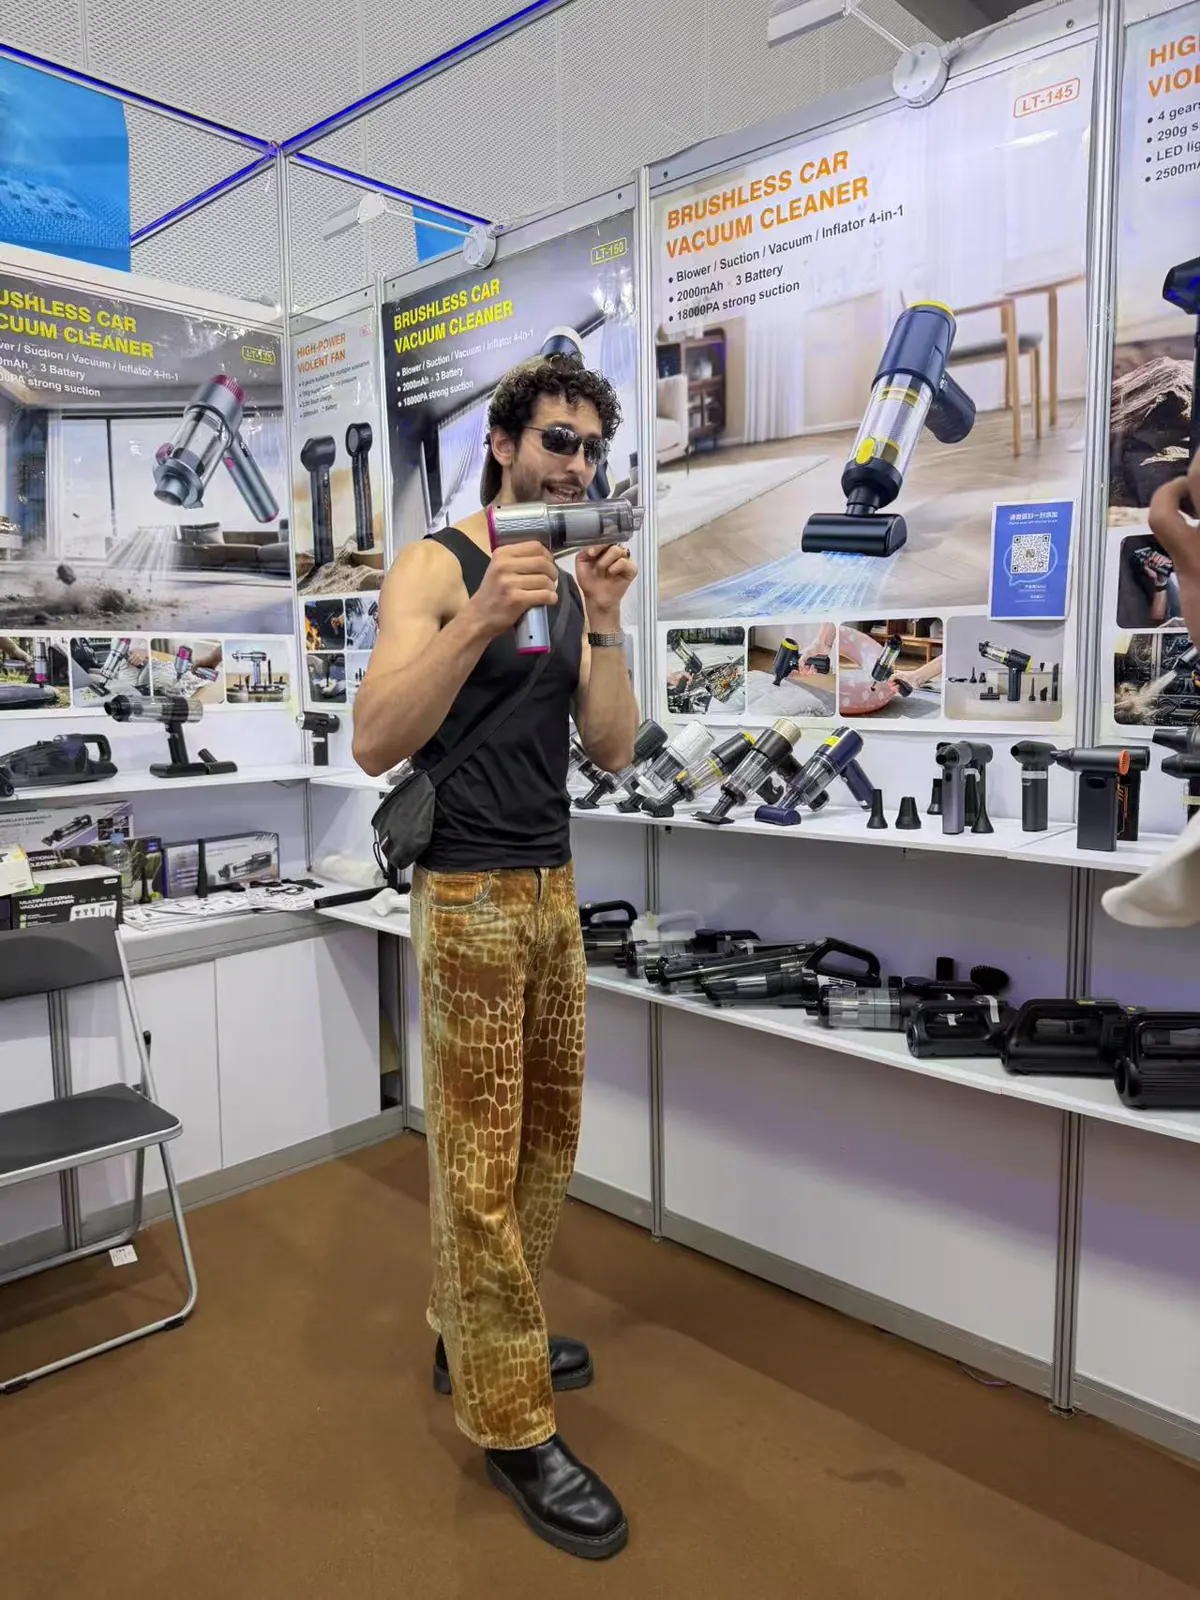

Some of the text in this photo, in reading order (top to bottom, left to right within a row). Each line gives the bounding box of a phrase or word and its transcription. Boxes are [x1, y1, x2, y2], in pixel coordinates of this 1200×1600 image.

[1023, 84, 1073, 112] LT-145
[1158, 111, 1165, 121] 4
[1157, 126, 1188, 142] 290g
[1157, 145, 1183, 161] LED
[667, 150, 849, 230] BRUSHLESS CAR
[666, 176, 869, 259] VACUUM CLEANER
[676, 264, 712, 282] Blower
[720, 251, 760, 270] Suction
[768, 234, 813, 255] Vacuum
[822, 217, 866, 239] Inflator
[869, 204, 904, 224] 4-in-1
[677, 281, 724, 302] 2000mAh
[735, 274, 742, 286] 3
[745, 264, 784, 283] Battery
[394, 277, 500, 331] BRUSHLESS CAR
[677, 281, 800, 321] 18000PA strong suction
[97, 310, 137, 334] CAR
[394, 299, 513, 354] VACUUM CLEANER
[63, 326, 154, 360] CLEANER
[297, 333, 346, 358] HIGH-POWER
[24, 344, 63, 361] Suction
[72, 353, 111, 370] Vacuum
[119, 362, 153, 377] Inflator
[40, 363, 47, 372] 3
[50, 365, 85, 381] Battery
[297, 349, 346, 373] VIOLENT FAN
[401, 363, 422, 377] Blower
[426, 355, 450, 368] Suction
[454, 345, 482, 359] Vacuum
[28, 377, 62, 392] strong
[64, 384, 101, 397] suction
[402, 367, 463, 392] 2000mAh 3 Battery
[428, 387, 449, 400] strong
[450, 380, 474, 394] suction
